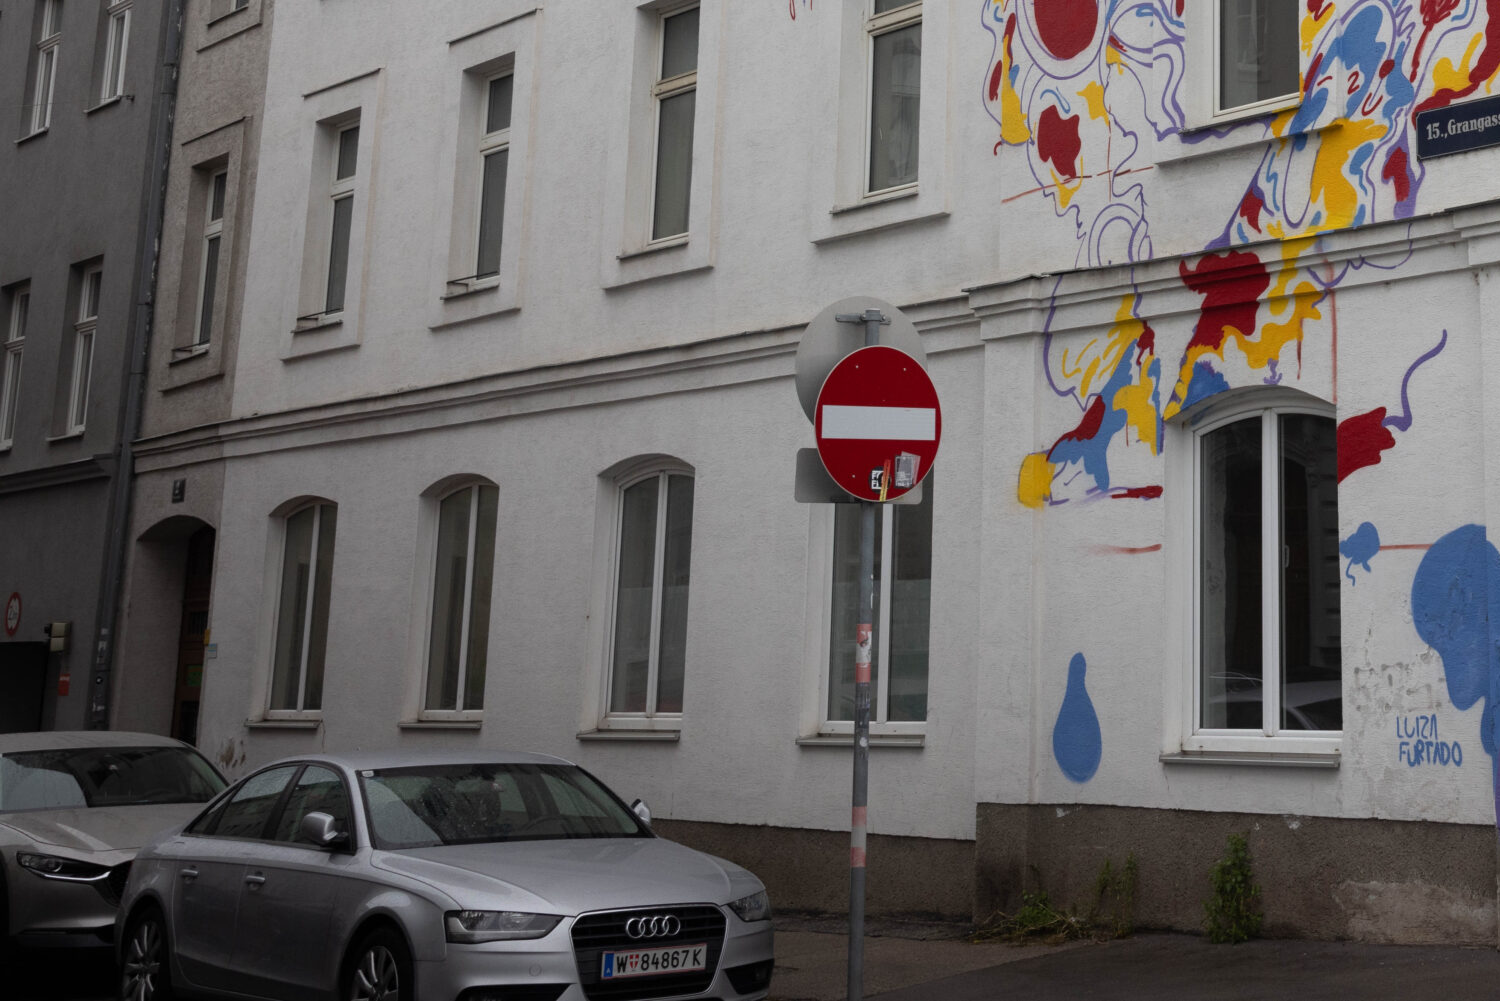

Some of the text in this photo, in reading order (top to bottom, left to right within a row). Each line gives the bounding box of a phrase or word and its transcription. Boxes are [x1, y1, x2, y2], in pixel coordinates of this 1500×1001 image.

[1396, 714, 1438, 740] LUIZA
[1398, 739, 1463, 767] FURTADO
[616, 949, 702, 972] W 84867 K
